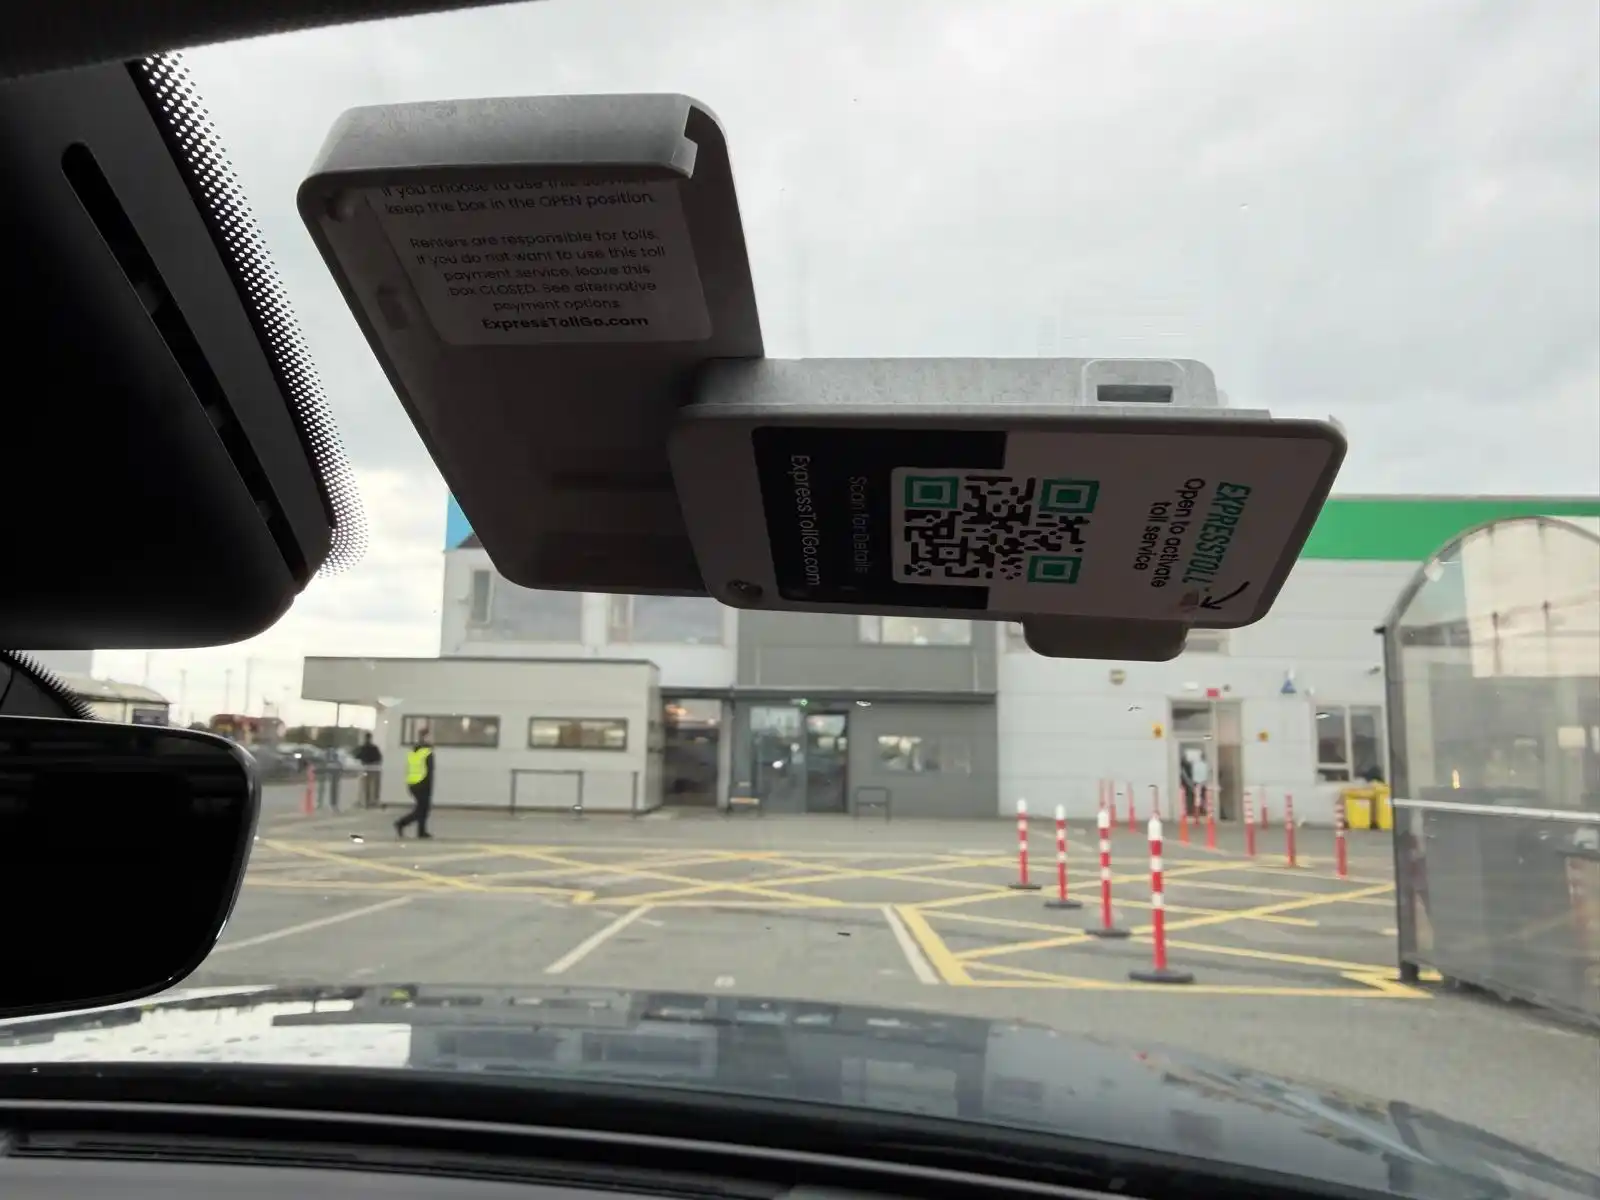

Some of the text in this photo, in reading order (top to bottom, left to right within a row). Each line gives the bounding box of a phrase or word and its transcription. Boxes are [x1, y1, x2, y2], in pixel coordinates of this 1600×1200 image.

[396, 184, 426, 200] you
[385, 204, 425, 216] keep
[427, 202, 455, 213] the
[457, 199, 487, 212] box
[490, 198, 505, 209] in
[508, 197, 535, 208] the
[539, 195, 582, 207] OPEN
[410, 238, 469, 249] Renters
[471, 236, 498, 246] are
[501, 231, 592, 247] responsible
[596, 230, 617, 241] for
[430, 256, 457, 268] you
[461, 253, 481, 264] do
[486, 251, 510, 262] not
[514, 250, 552, 262] want
[556, 250, 573, 260] to
[577, 249, 605, 259] use
[609, 246, 637, 258] this
[641, 245, 666, 257] toll
[443, 268, 511, 282] payment
[575, 265, 619, 276] leave
[622, 263, 651, 275] this
[449, 286, 477, 296] box
[574, 280, 657, 293] alternative
[493, 299, 560, 314] payment
[481, 316, 649, 331] ExpressTollGo.com
[787, 455, 821, 586] ExpressTollGo.com
[848, 476, 872, 574] Scan for Details
[1133, 501, 1172, 570] toll service
[1151, 477, 1206, 588] Open to activate
[1182, 481, 1252, 584] EXPRESSTOLL
